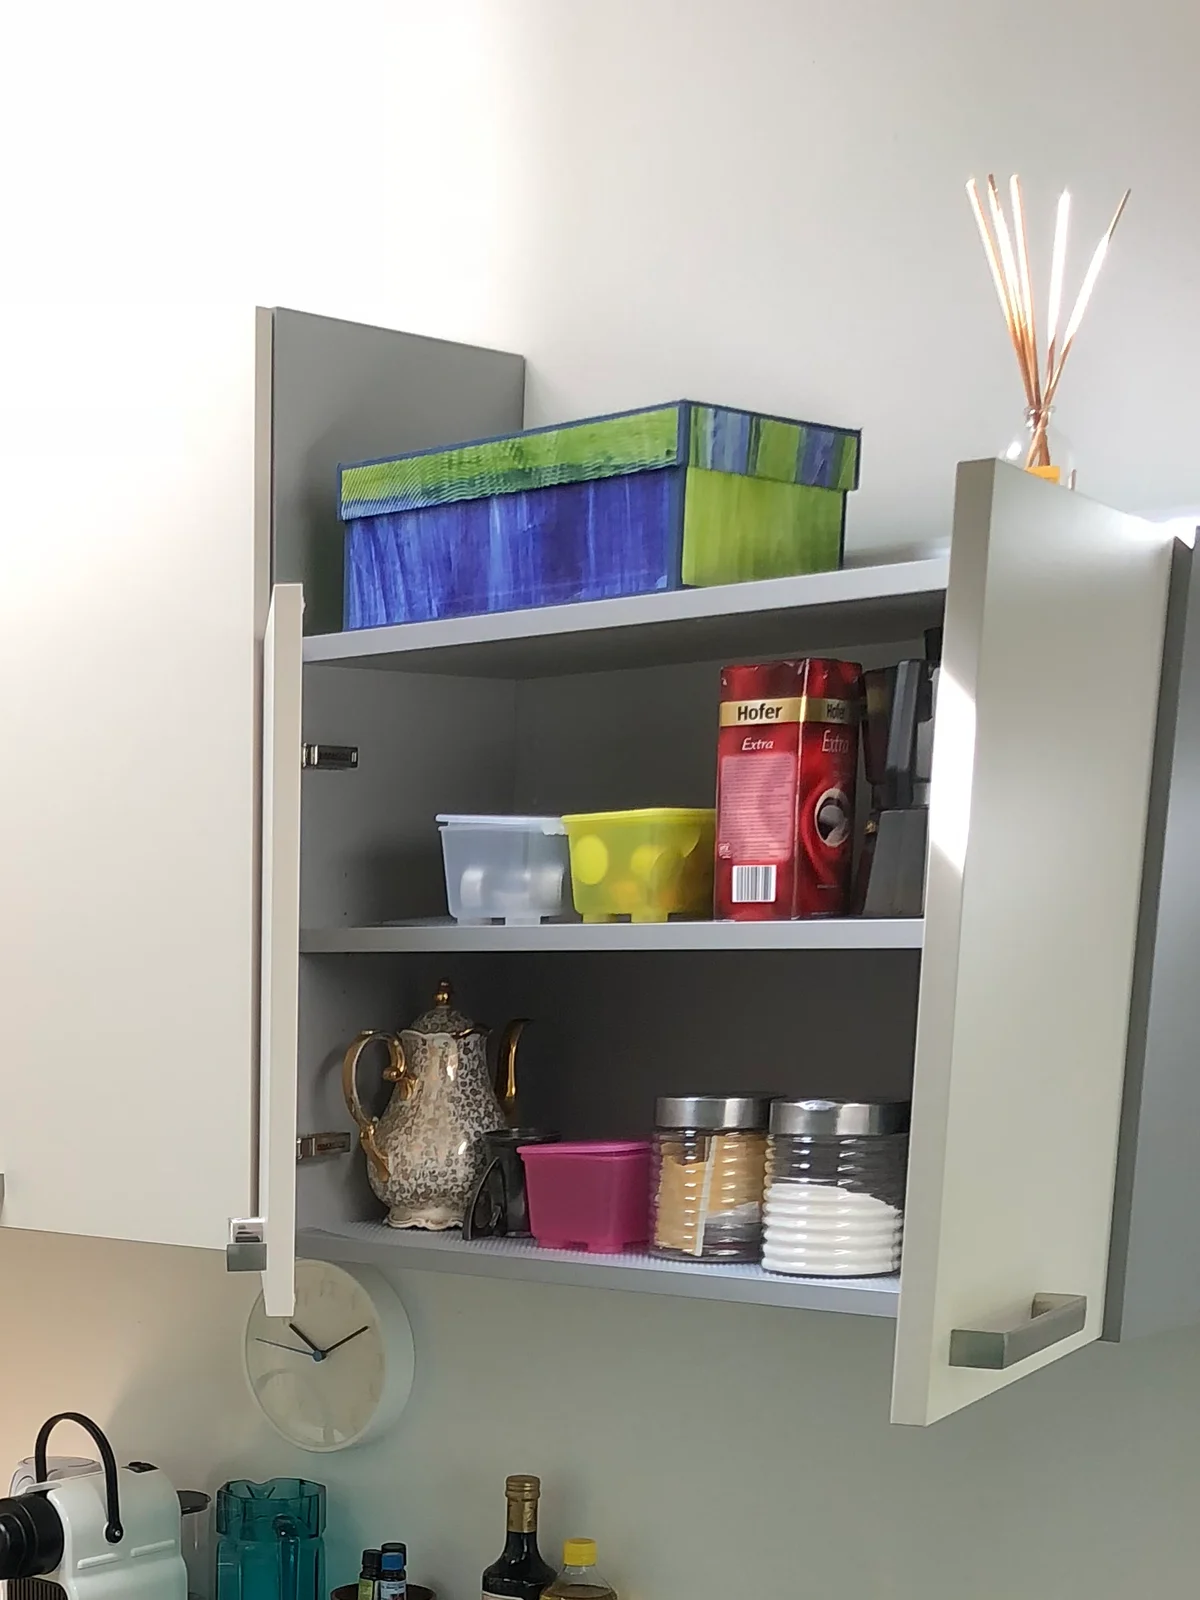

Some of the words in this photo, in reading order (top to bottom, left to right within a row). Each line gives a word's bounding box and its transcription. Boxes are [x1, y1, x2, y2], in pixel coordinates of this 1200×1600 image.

[737, 704, 782, 721] Hofer
[826, 703, 846, 720] Hofer
[742, 737, 774, 751] Extra
